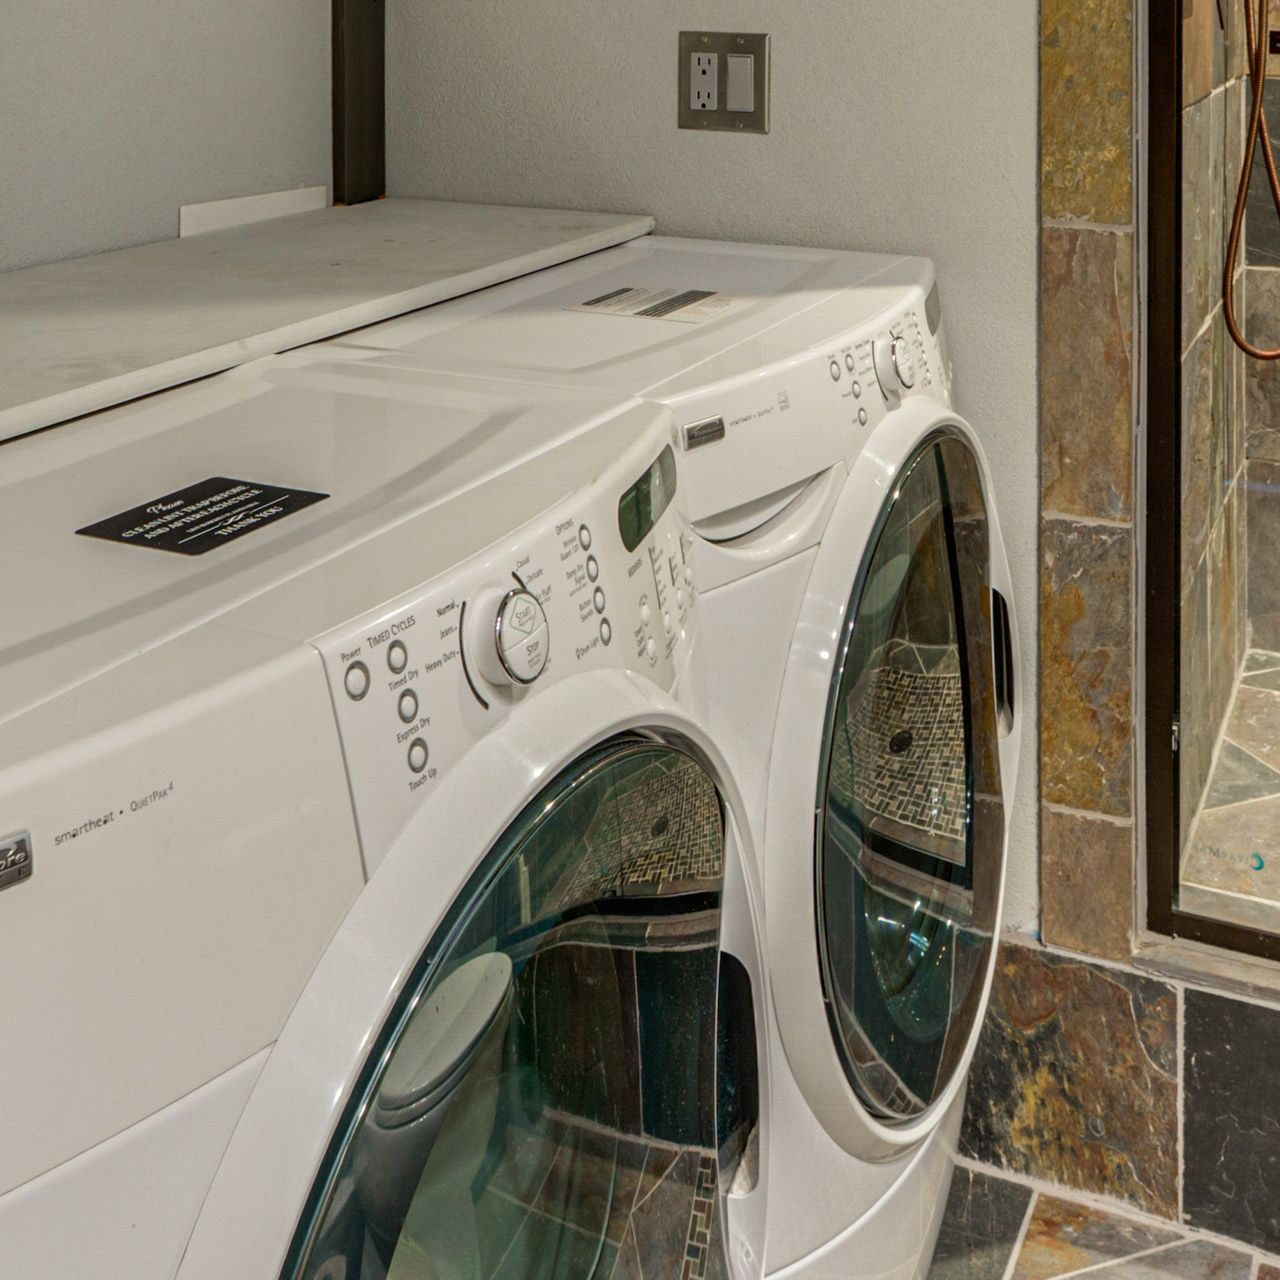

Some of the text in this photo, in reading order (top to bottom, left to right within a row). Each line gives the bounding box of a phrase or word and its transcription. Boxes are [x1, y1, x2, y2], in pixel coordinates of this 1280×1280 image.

[437, 600, 455, 617] Normal
[367, 615, 416, 649] TIMED CYCLES
[440, 625, 454, 640] Jeans
[340, 646, 361, 662] Power
[425, 650, 456, 673] Heavy Duty
[388, 668, 419, 692] Timed Dry
[396, 716, 431, 744] Express Dry
[408, 767, 437, 793] Touch Up
[55, 811, 115, 846] smartheat
